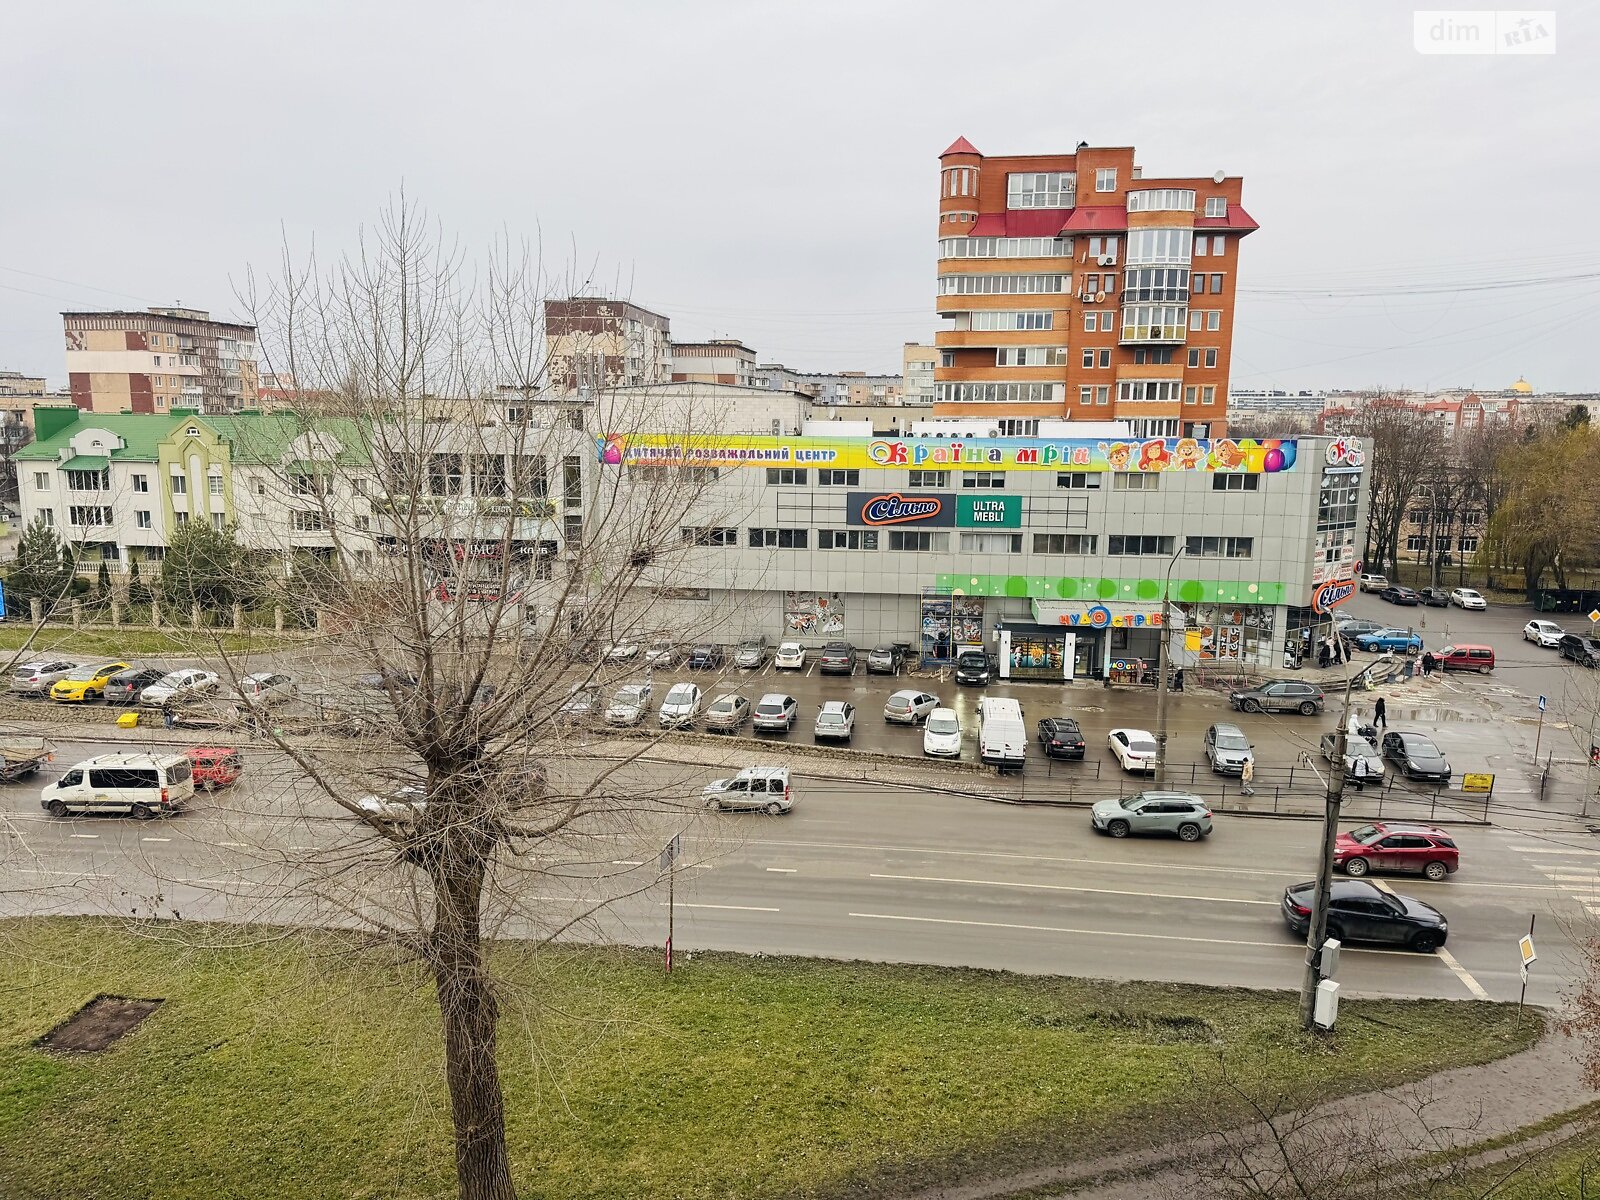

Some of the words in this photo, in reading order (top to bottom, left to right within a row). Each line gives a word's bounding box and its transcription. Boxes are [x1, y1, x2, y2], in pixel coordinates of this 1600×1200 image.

[795, 450, 836, 462] ЦЕНТР
[868, 440, 1003, 466] Країна
[1016, 444, 1091, 466] мрій
[869, 497, 937, 520] Сільпо
[973, 501, 1005, 511] ULTRA
[973, 512, 1004, 522] MEBLI
[1319, 584, 1354, 608] Сільпо
